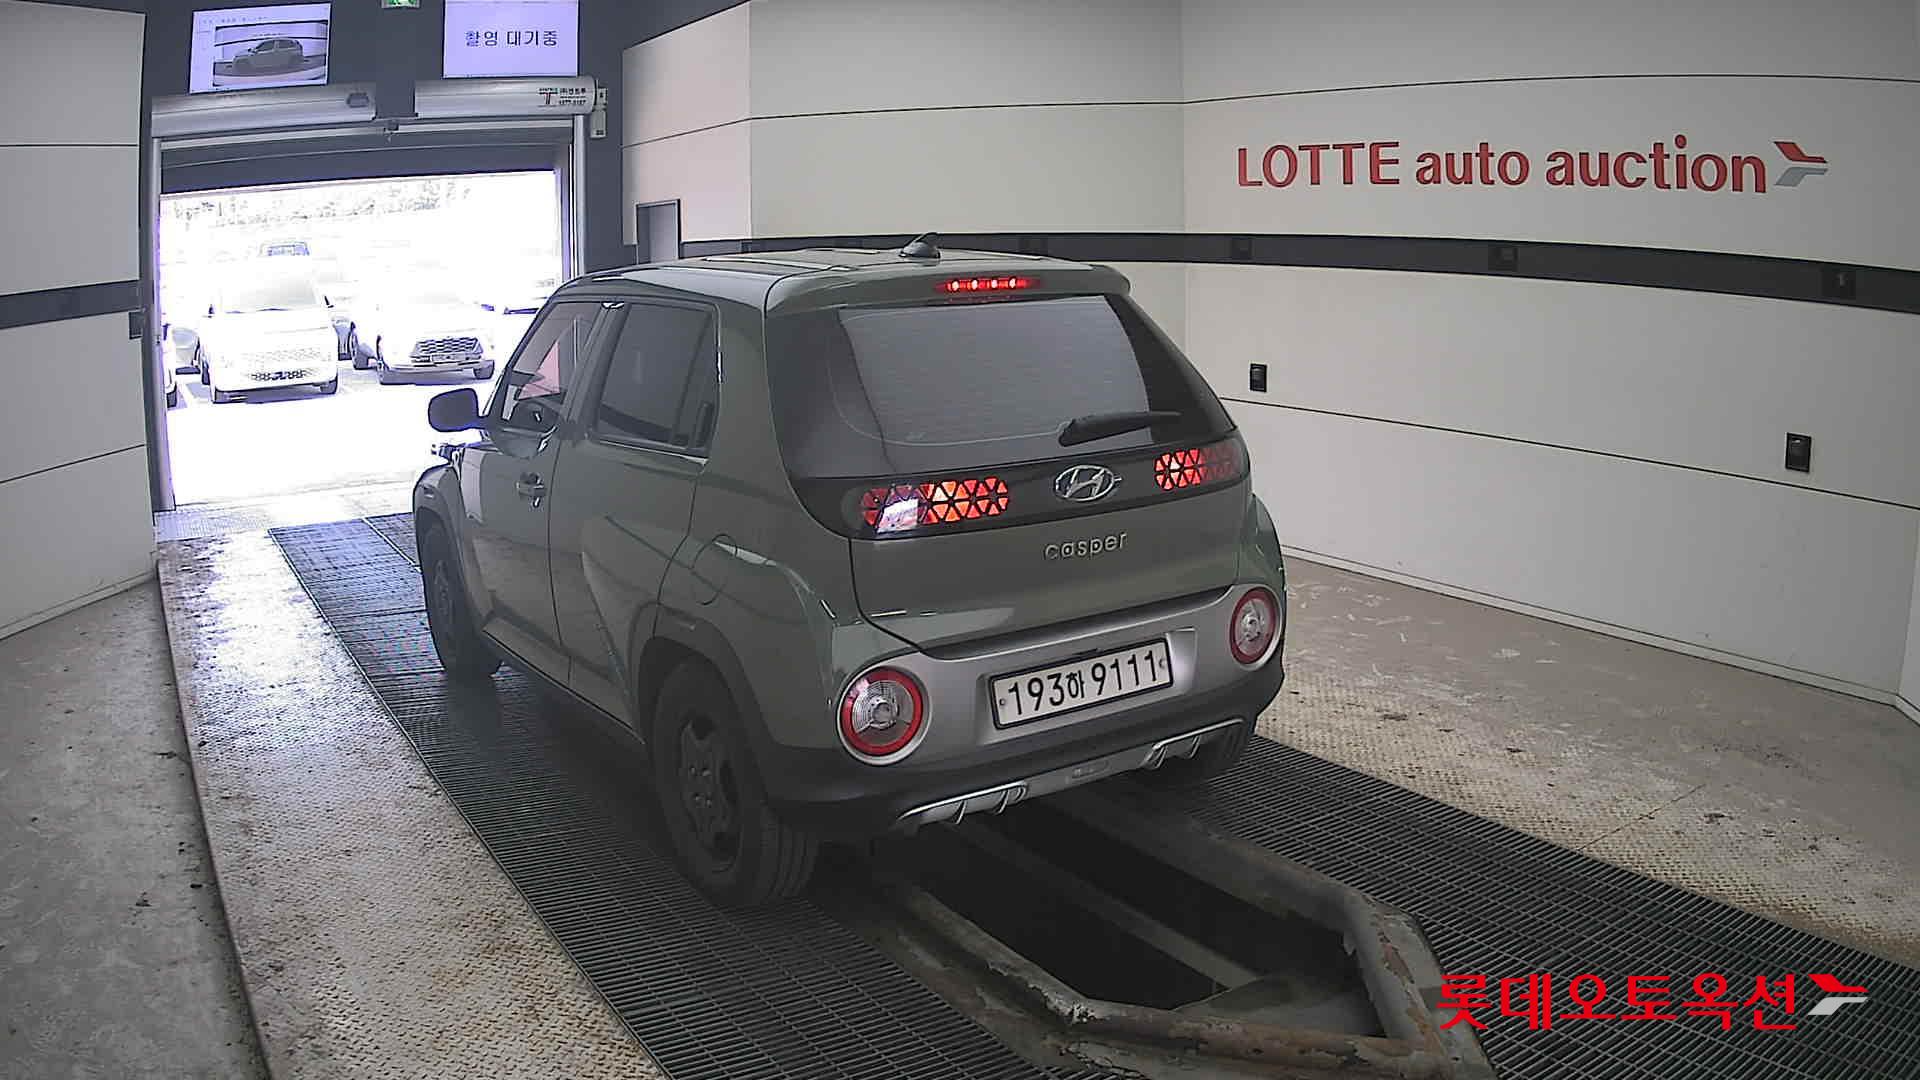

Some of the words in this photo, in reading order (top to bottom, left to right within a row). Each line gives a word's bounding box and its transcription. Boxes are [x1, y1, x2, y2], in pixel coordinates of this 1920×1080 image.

[466, 30, 498, 47] 촬영
[1237, 142, 1400, 188] LOTTE
[1416, 142, 1531, 186] auto
[1545, 135, 1767, 193] auction
[1044, 531, 1128, 560] casper
